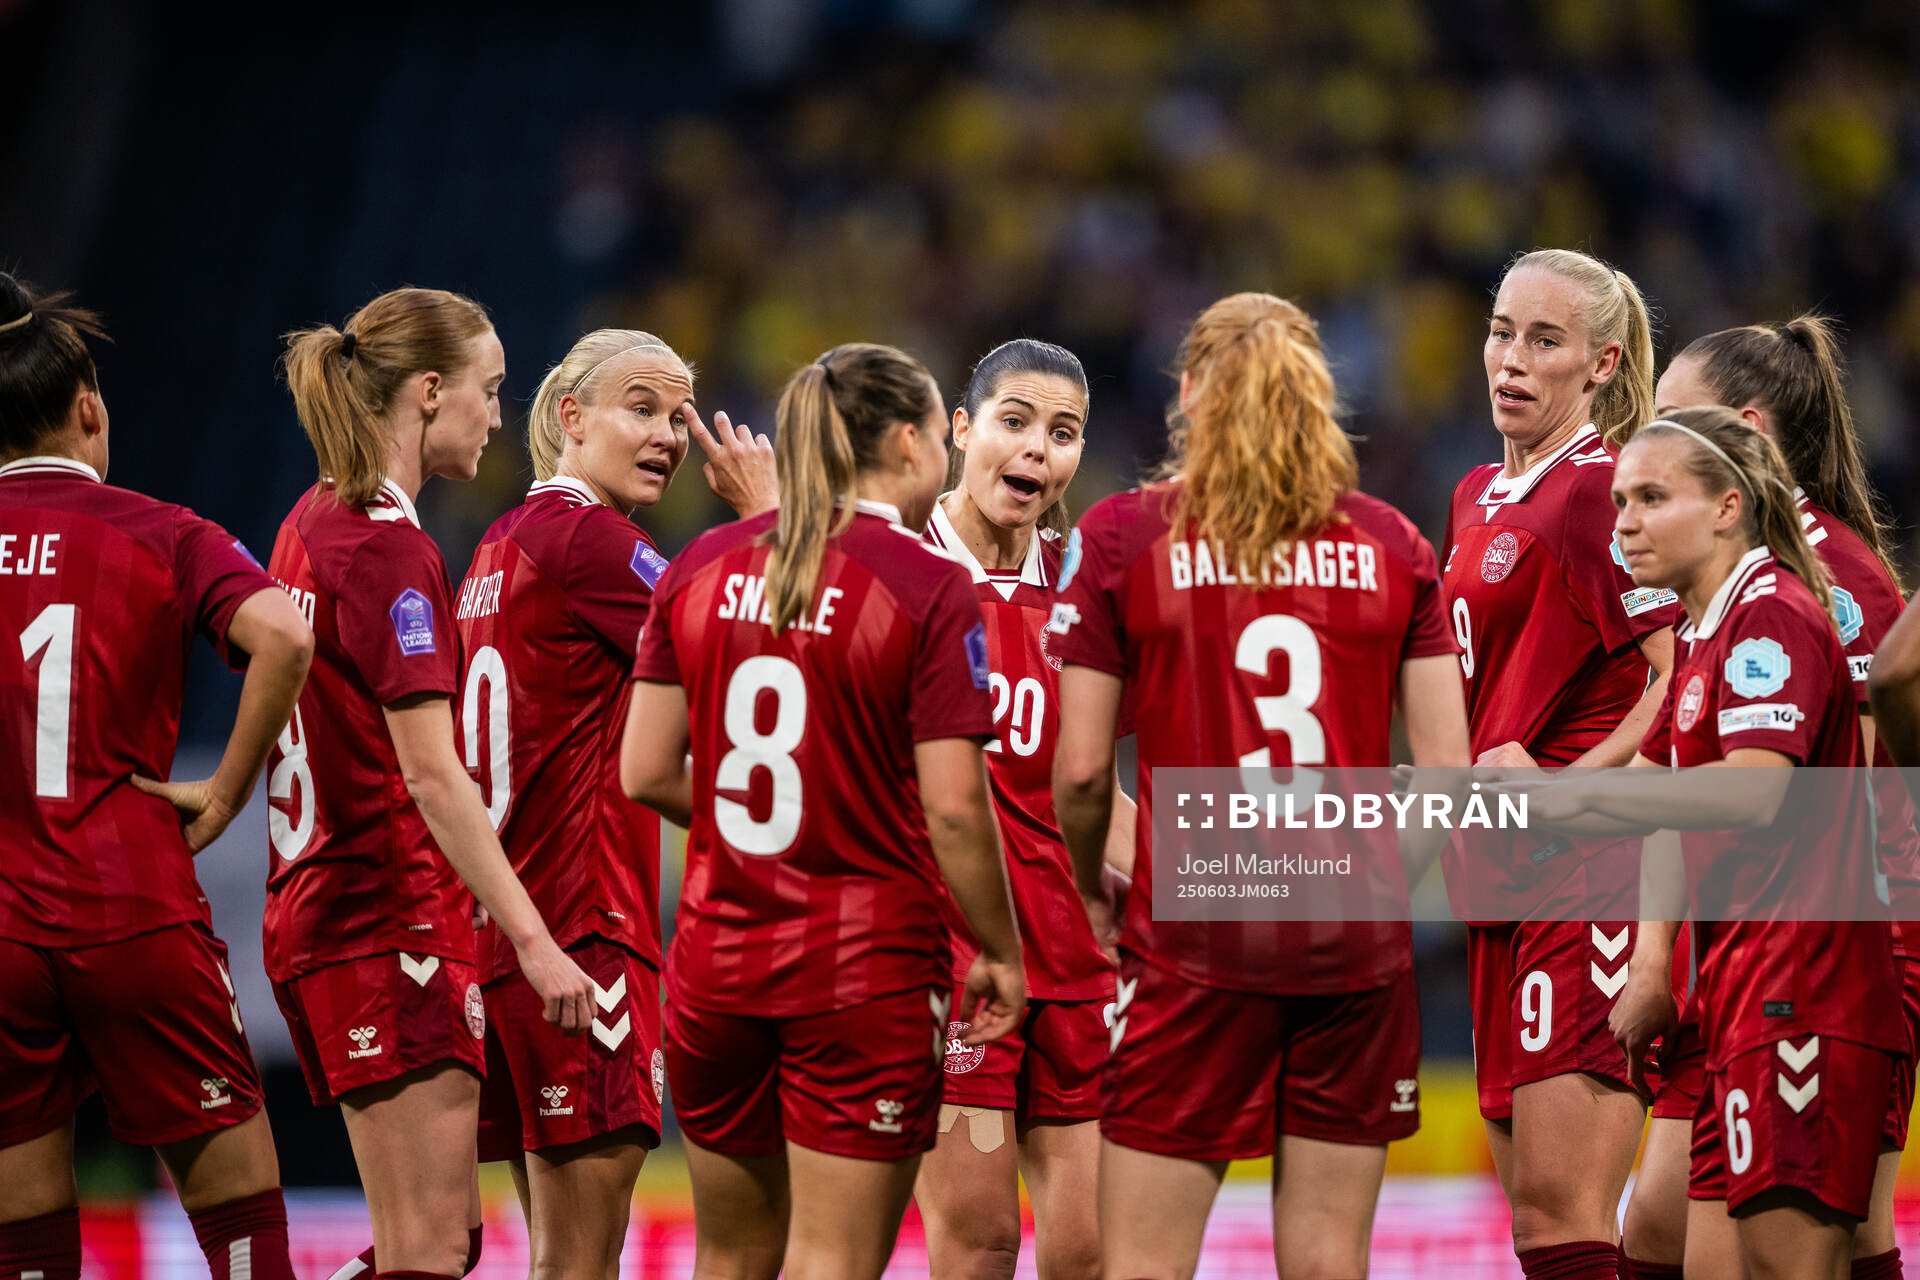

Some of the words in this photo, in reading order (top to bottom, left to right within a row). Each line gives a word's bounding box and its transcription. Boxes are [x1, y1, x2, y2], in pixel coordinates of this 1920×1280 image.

[456, 570, 504, 620] HARDER
[1487, 548, 1510, 564] DBU
[718, 573, 844, 635] SNE
[1453, 597, 1475, 679] 9
[1624, 587, 1675, 609] FOUNDATION
[19, 603, 76, 798] 1
[982, 671, 1045, 757] 20
[1235, 613, 1326, 817] 3
[714, 655, 808, 856] 8
[348, 1044, 382, 1060] hummel
[1520, 970, 1553, 1052] 9
[539, 1105, 574, 1117] hummel
[1725, 1087, 1753, 1175] 6
